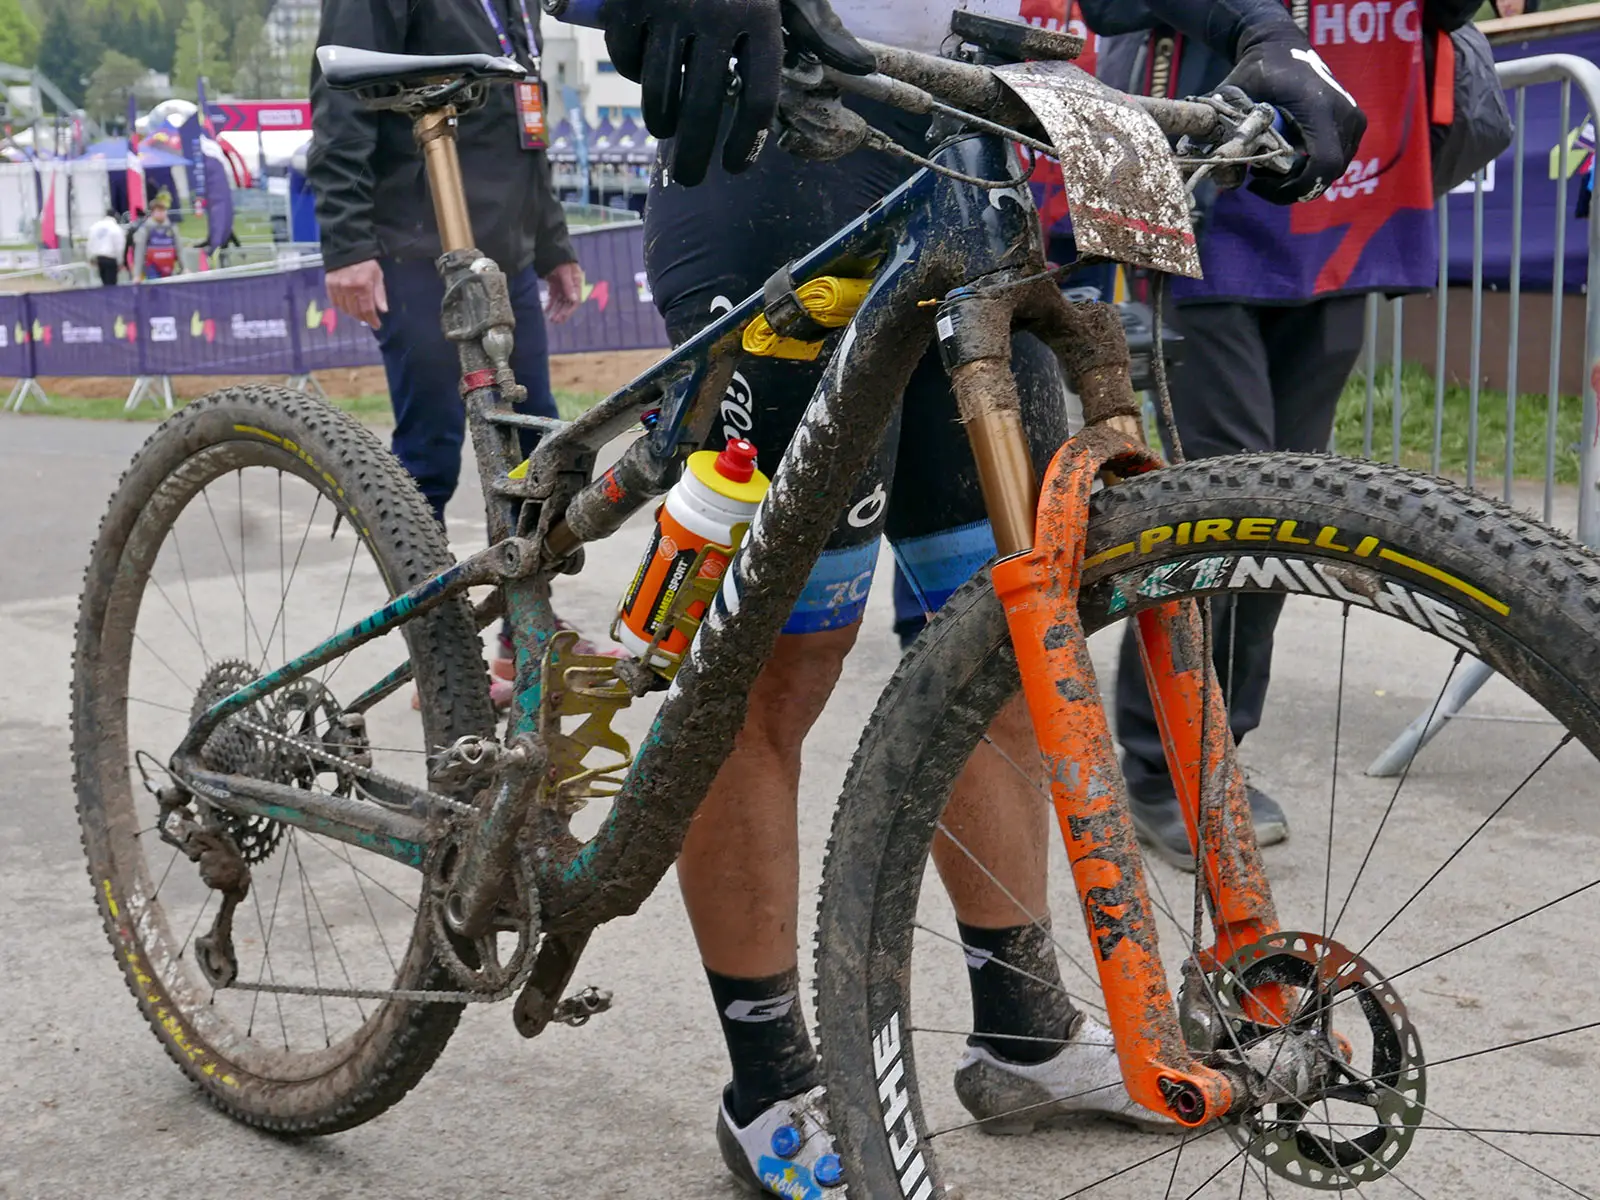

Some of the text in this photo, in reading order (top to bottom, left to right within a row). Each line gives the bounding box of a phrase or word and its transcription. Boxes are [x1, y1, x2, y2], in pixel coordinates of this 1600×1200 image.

[1140, 517, 1379, 558] PIRELLI
[653, 557, 689, 625] NAMEDSPORT
[1229, 556, 1481, 655] MICHE
[872, 1010, 933, 1200] ICHE
